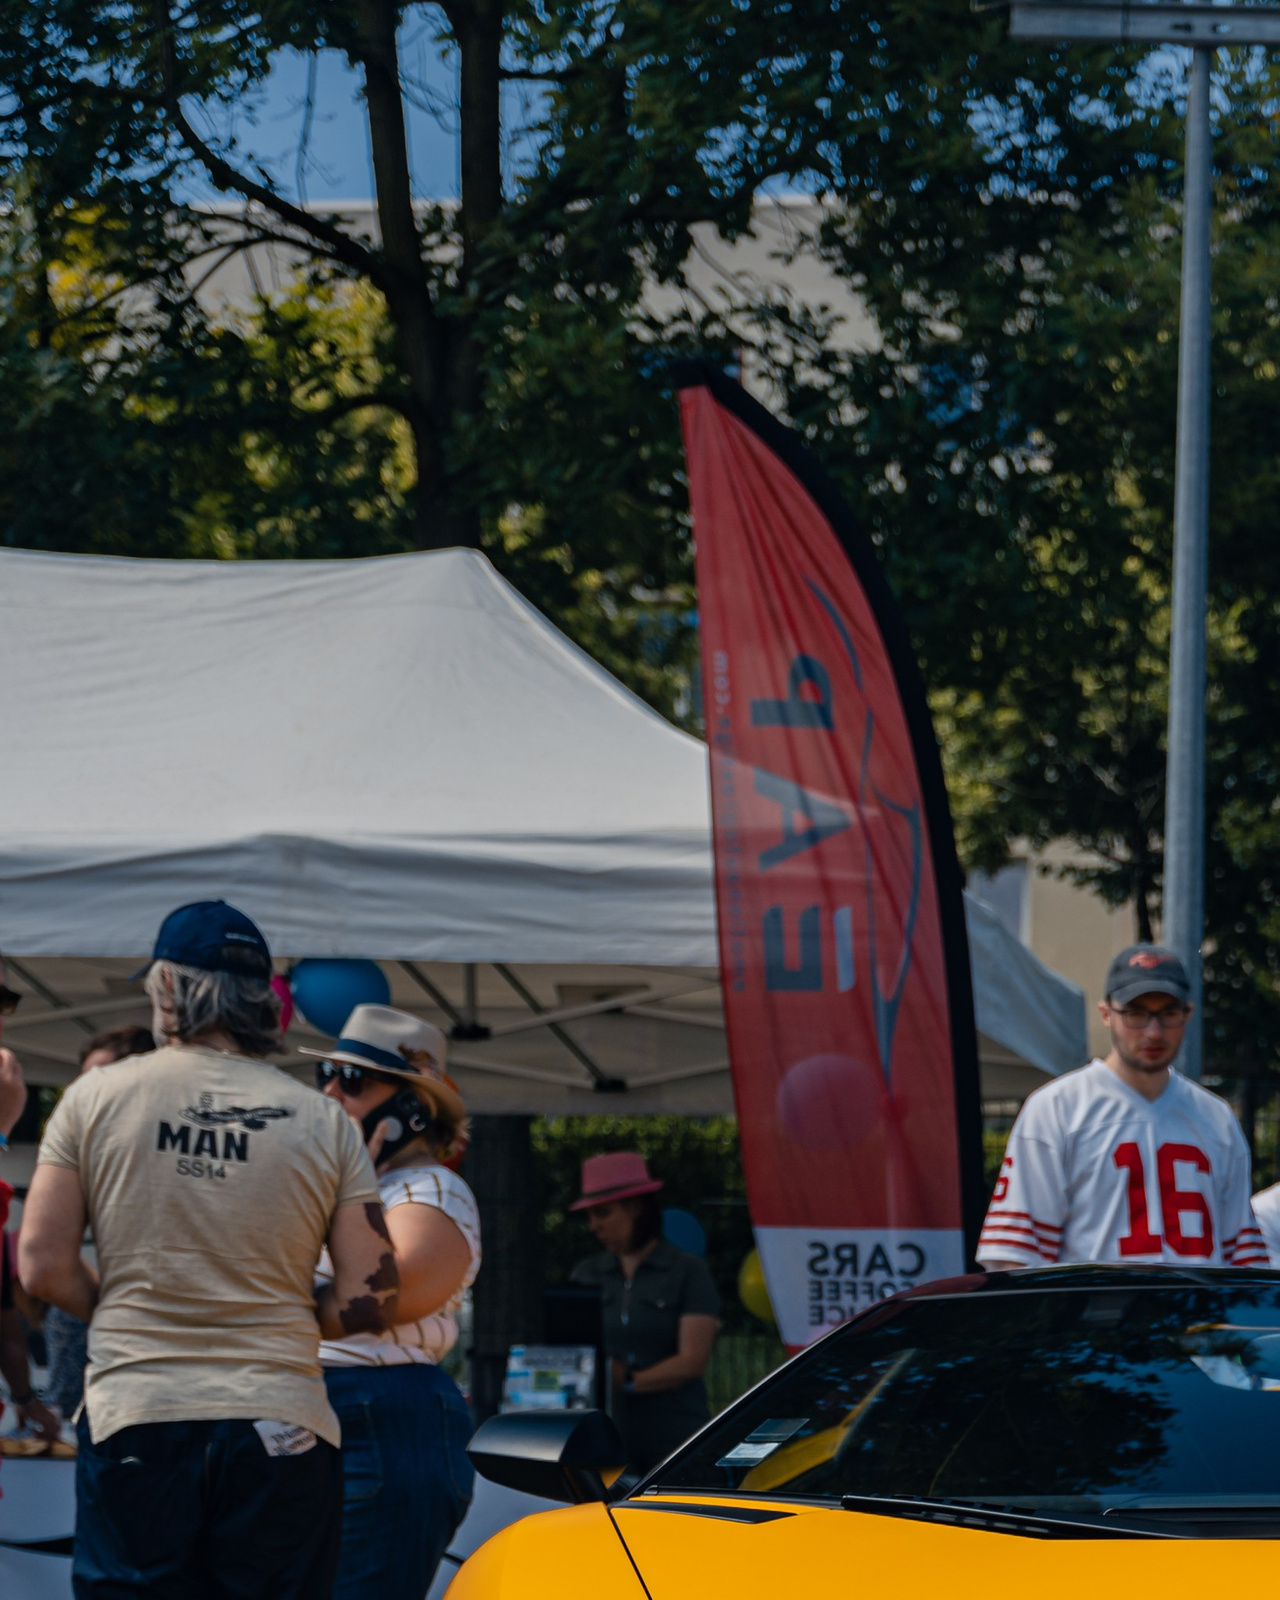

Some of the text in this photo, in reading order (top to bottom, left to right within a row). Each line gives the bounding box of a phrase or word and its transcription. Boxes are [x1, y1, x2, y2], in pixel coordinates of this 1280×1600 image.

[157, 1121, 249, 1162] MAN
[177, 1159, 226, 1179] SS14
[1111, 1141, 1215, 1258] 16
